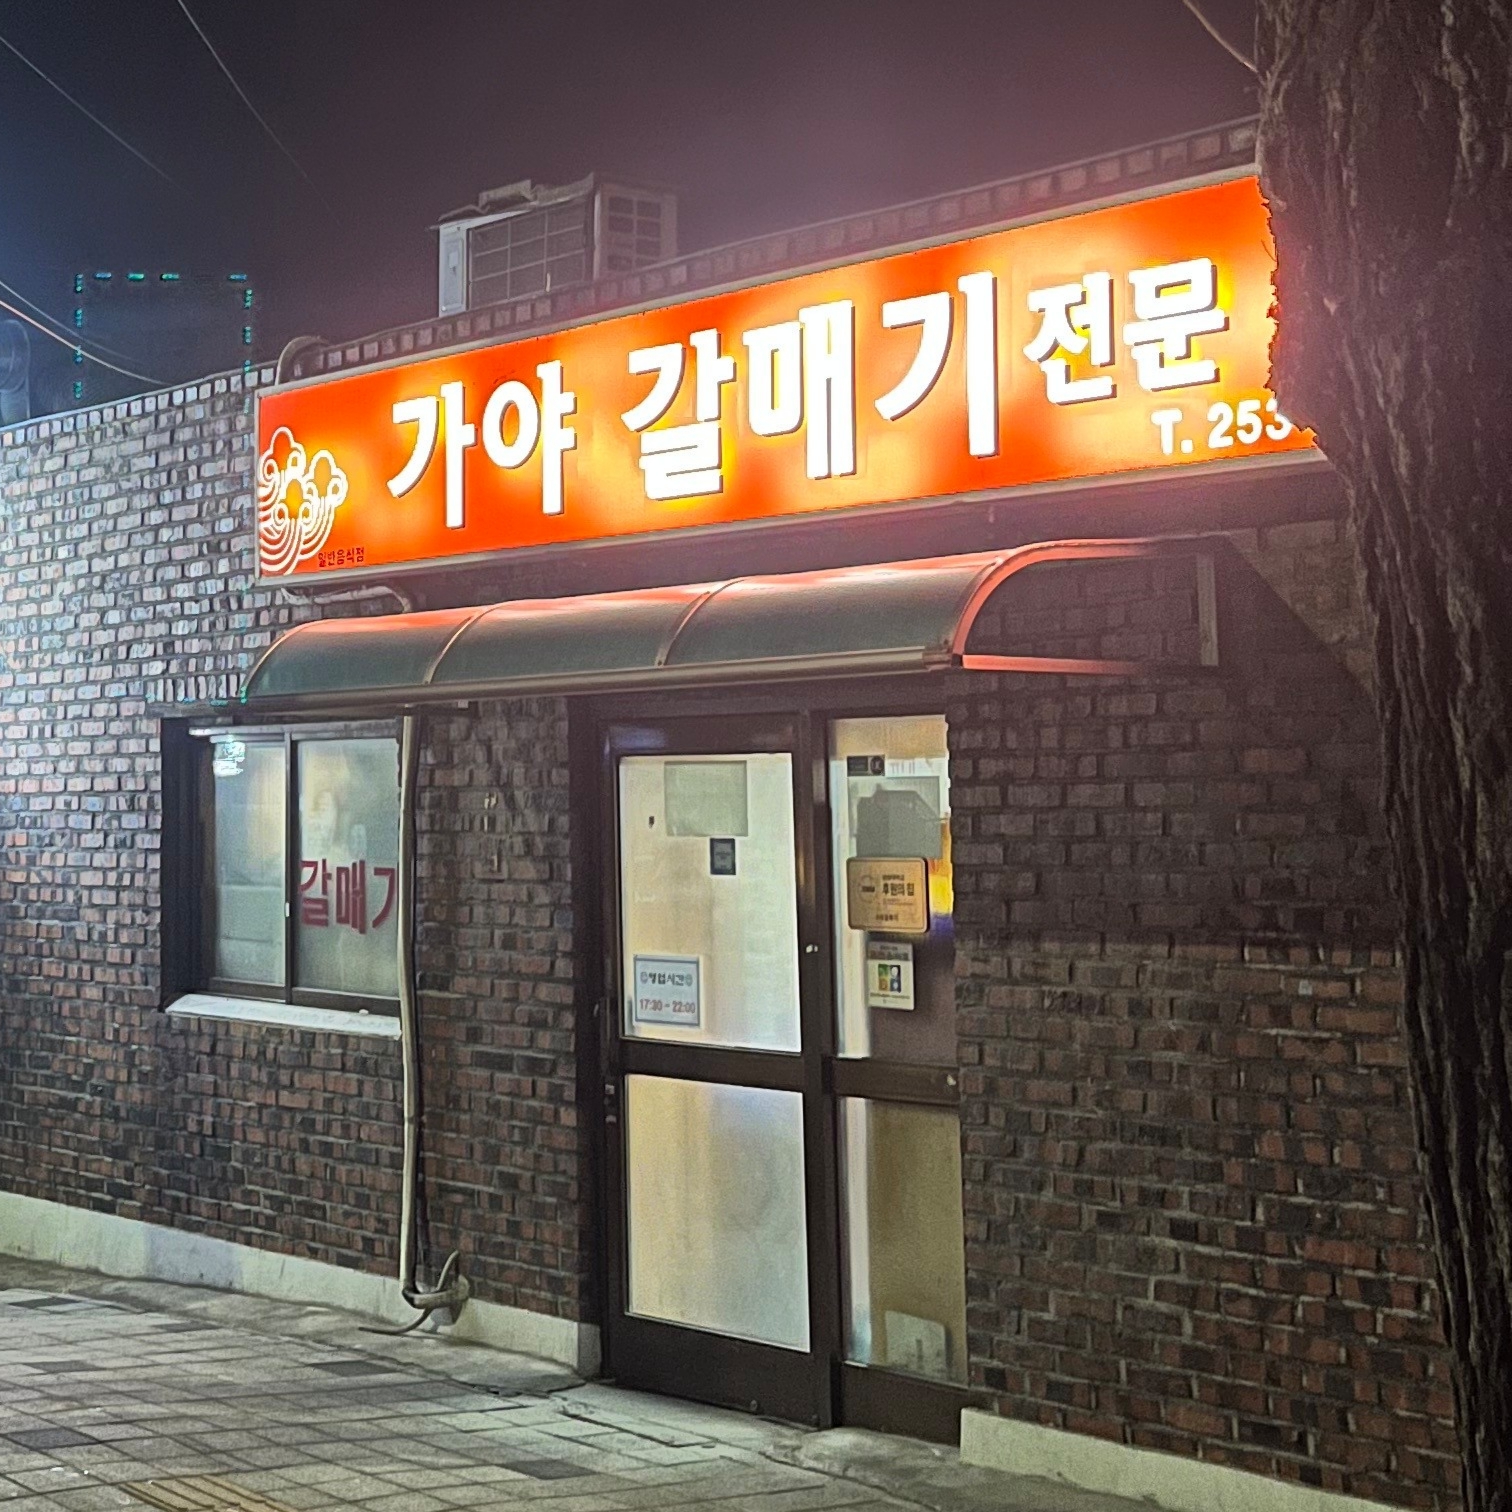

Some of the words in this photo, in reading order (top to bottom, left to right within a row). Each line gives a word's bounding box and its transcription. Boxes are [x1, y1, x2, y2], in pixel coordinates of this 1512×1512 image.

[387, 359, 578, 529] 가야
[622, 274, 998, 503] 갈매기
[1022, 257, 1231, 406] 전문
[1150, 408, 1193, 455] T.
[318, 547, 364, 568] 일반음식점
[649, 972, 684, 986] 영업시간
